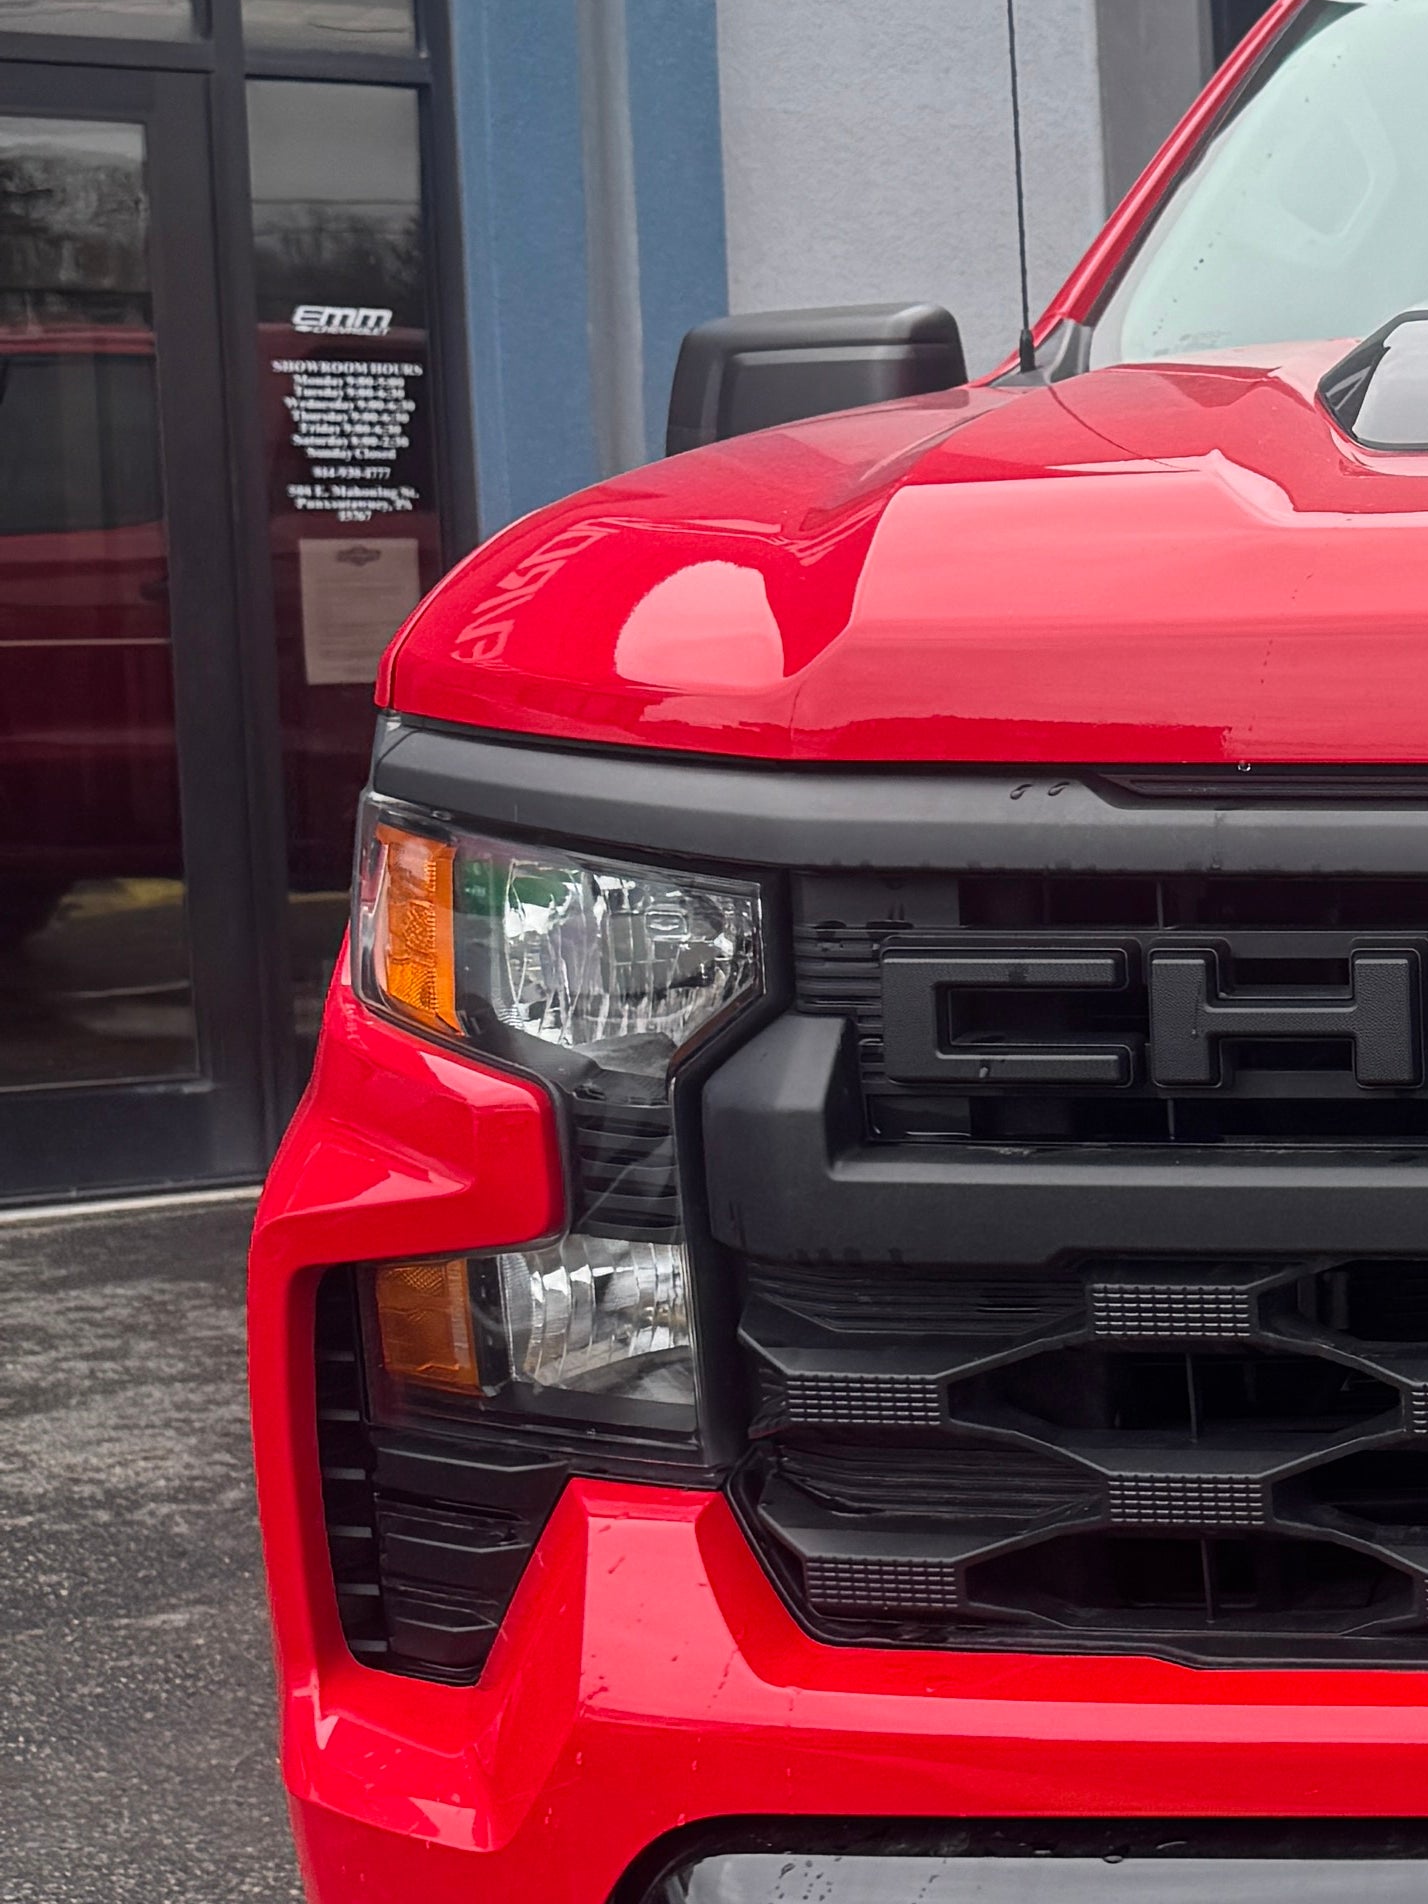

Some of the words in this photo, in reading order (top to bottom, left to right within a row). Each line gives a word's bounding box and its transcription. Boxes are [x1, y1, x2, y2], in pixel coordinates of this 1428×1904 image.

[292, 305, 393, 328] EMM
[271, 360, 368, 375] SHOWROOM
[370, 362, 424, 376] HOURS
[293, 374, 344, 387] Monday
[293, 385, 344, 399] Tuesday
[284, 396, 354, 410] Wednesday
[291, 409, 348, 423] Thursday
[301, 422, 340, 436] Friday
[292, 434, 349, 448] Saturday
[306, 447, 352, 461] Sunday
[354, 448, 396, 460] Closed
